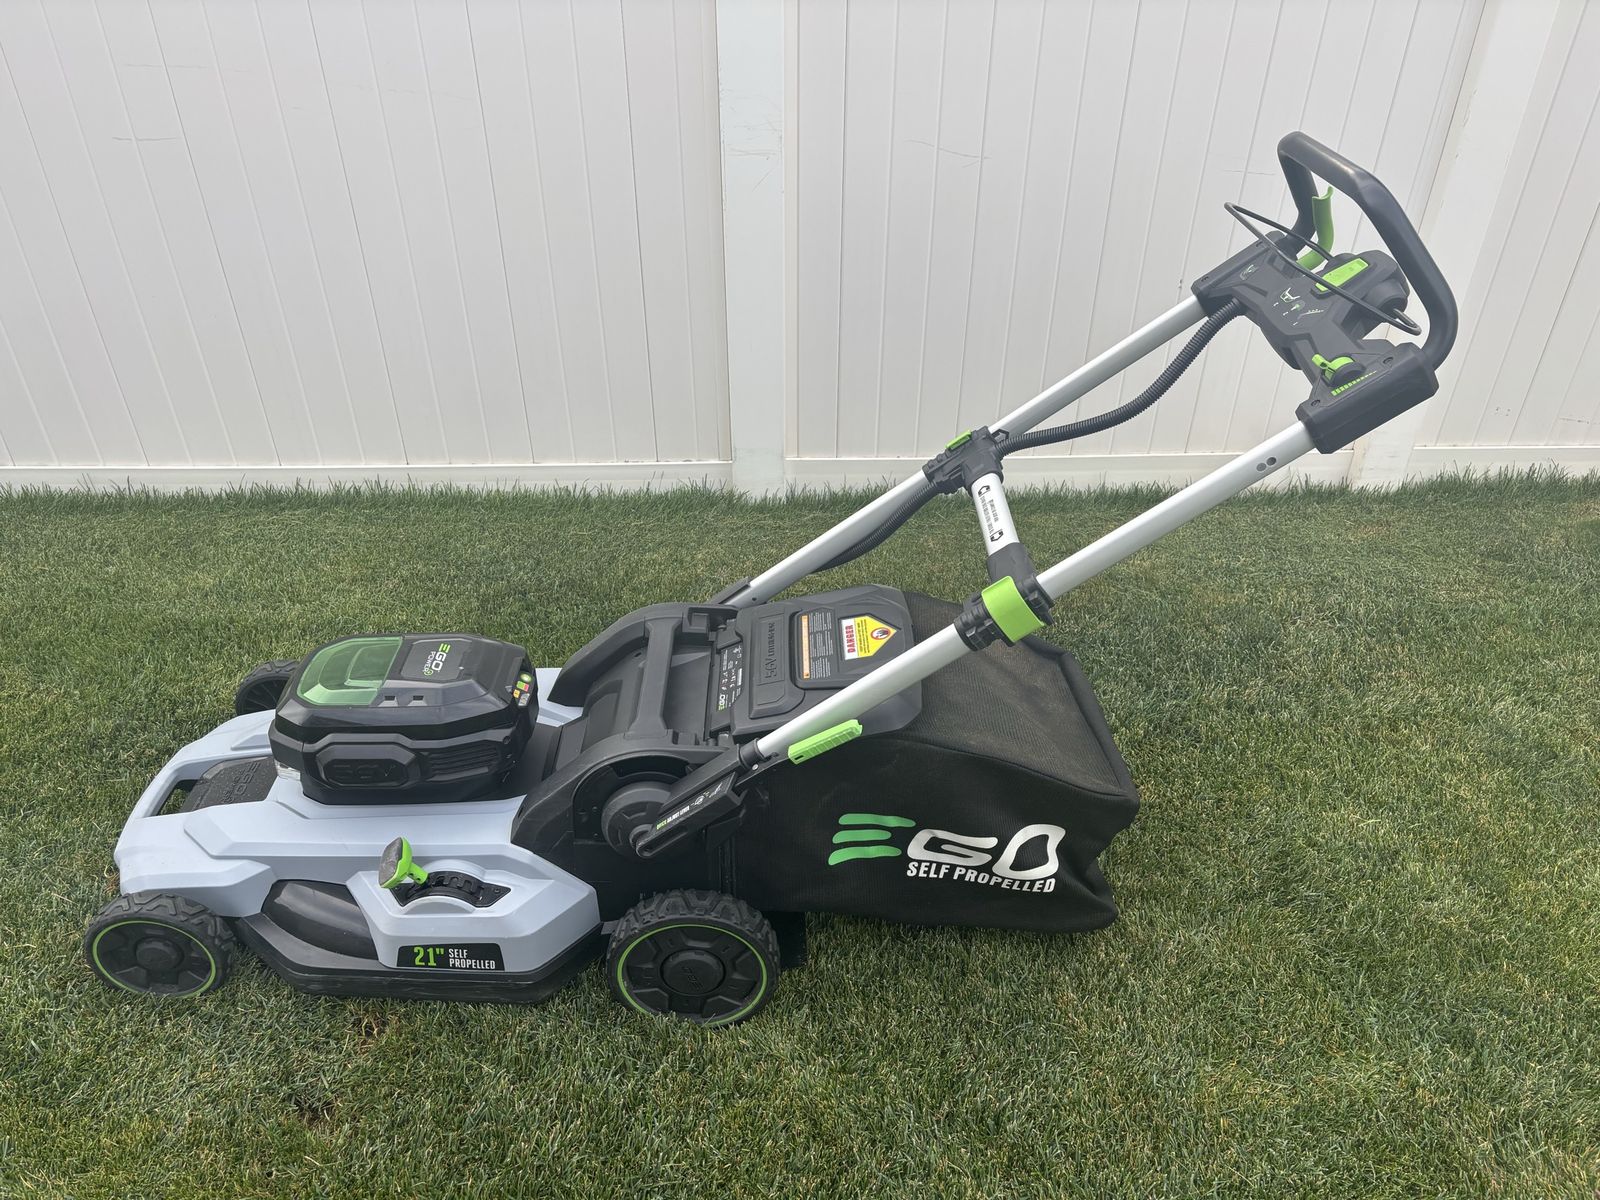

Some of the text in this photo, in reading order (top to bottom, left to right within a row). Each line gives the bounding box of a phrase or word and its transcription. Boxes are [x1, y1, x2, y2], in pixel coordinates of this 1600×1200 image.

[846, 624, 855, 654] DANGER
[431, 643, 451, 671] EGO
[827, 813, 1066, 880] EGO
[906, 861, 1057, 894] SELF PROPELLED
[413, 946, 445, 967] 21"
[448, 948, 468, 959] SELF
[449, 958, 496, 970] PROPELLED
